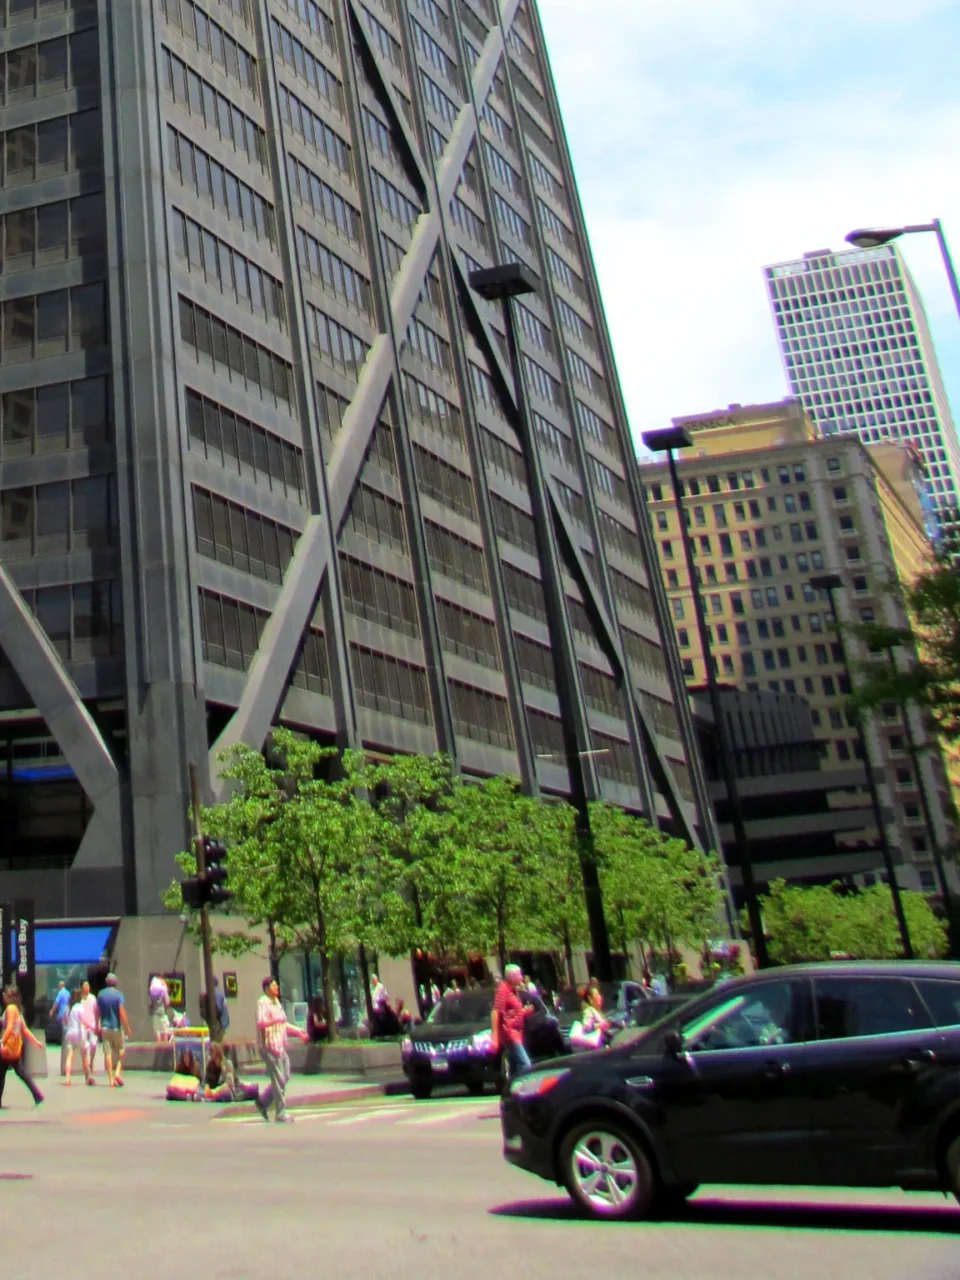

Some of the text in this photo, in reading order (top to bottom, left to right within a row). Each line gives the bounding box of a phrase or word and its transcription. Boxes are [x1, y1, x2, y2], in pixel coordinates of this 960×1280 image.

[683, 416, 735, 431] SENECA
[18, 918, 29, 973] Best Buy
